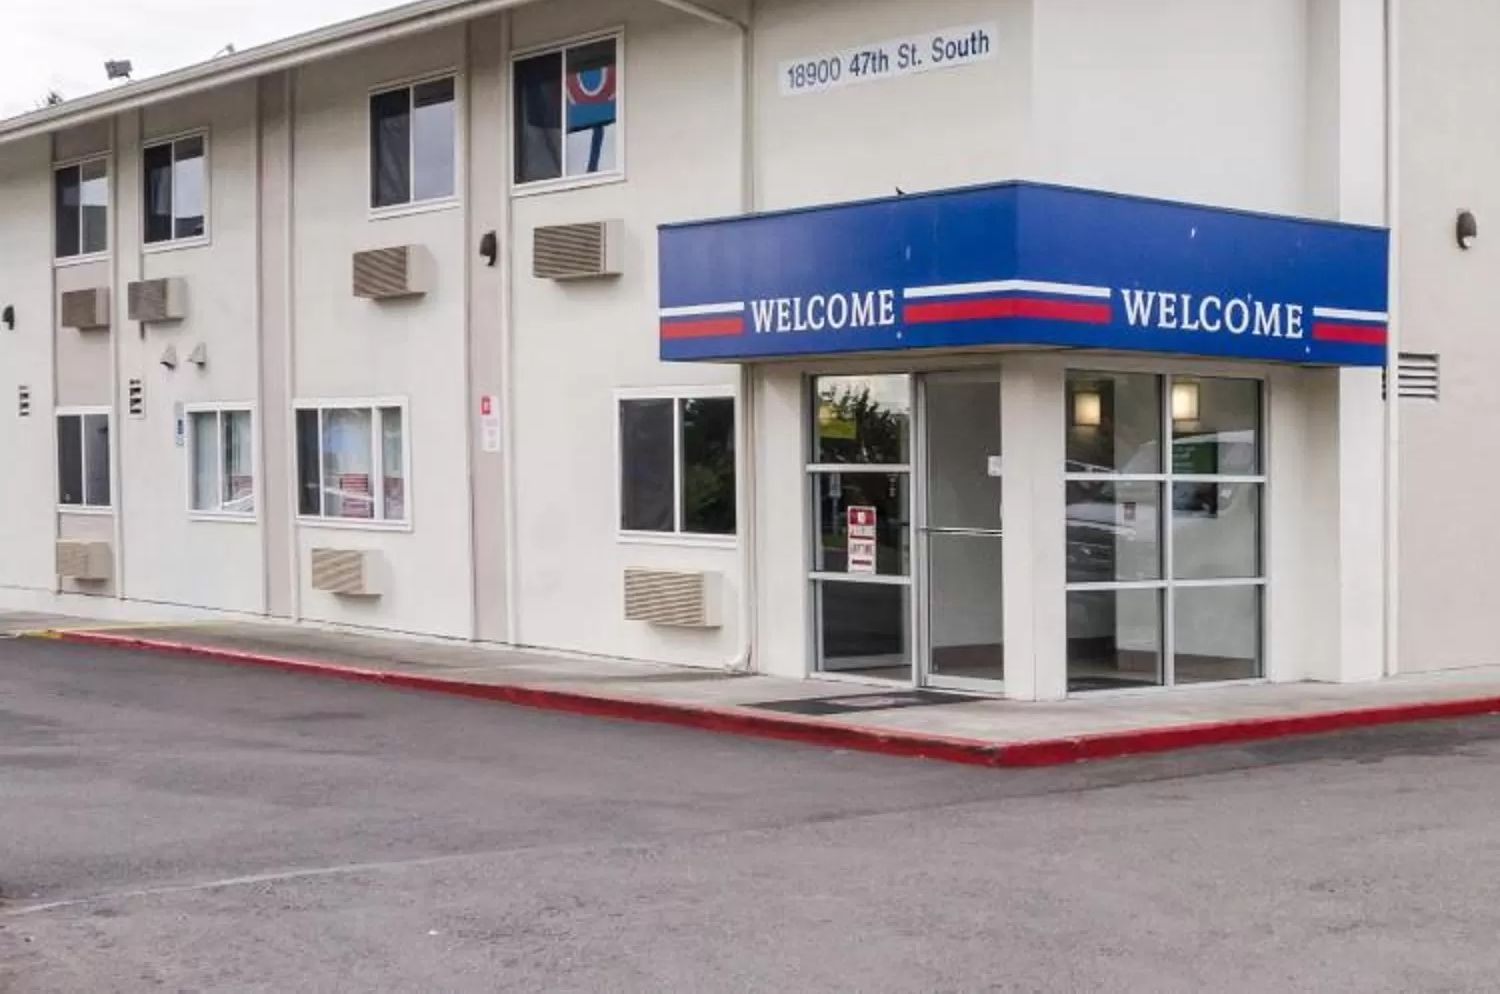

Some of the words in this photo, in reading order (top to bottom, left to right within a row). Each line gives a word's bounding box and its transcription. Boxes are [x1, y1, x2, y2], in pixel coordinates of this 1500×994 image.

[788, 57, 841, 88] 18900
[850, 49, 889, 76] 47th
[897, 43, 922, 69] St.
[932, 30, 990, 63] South
[751, 289, 896, 333] WELCOME
[1121, 288, 1304, 340] WELCOME
